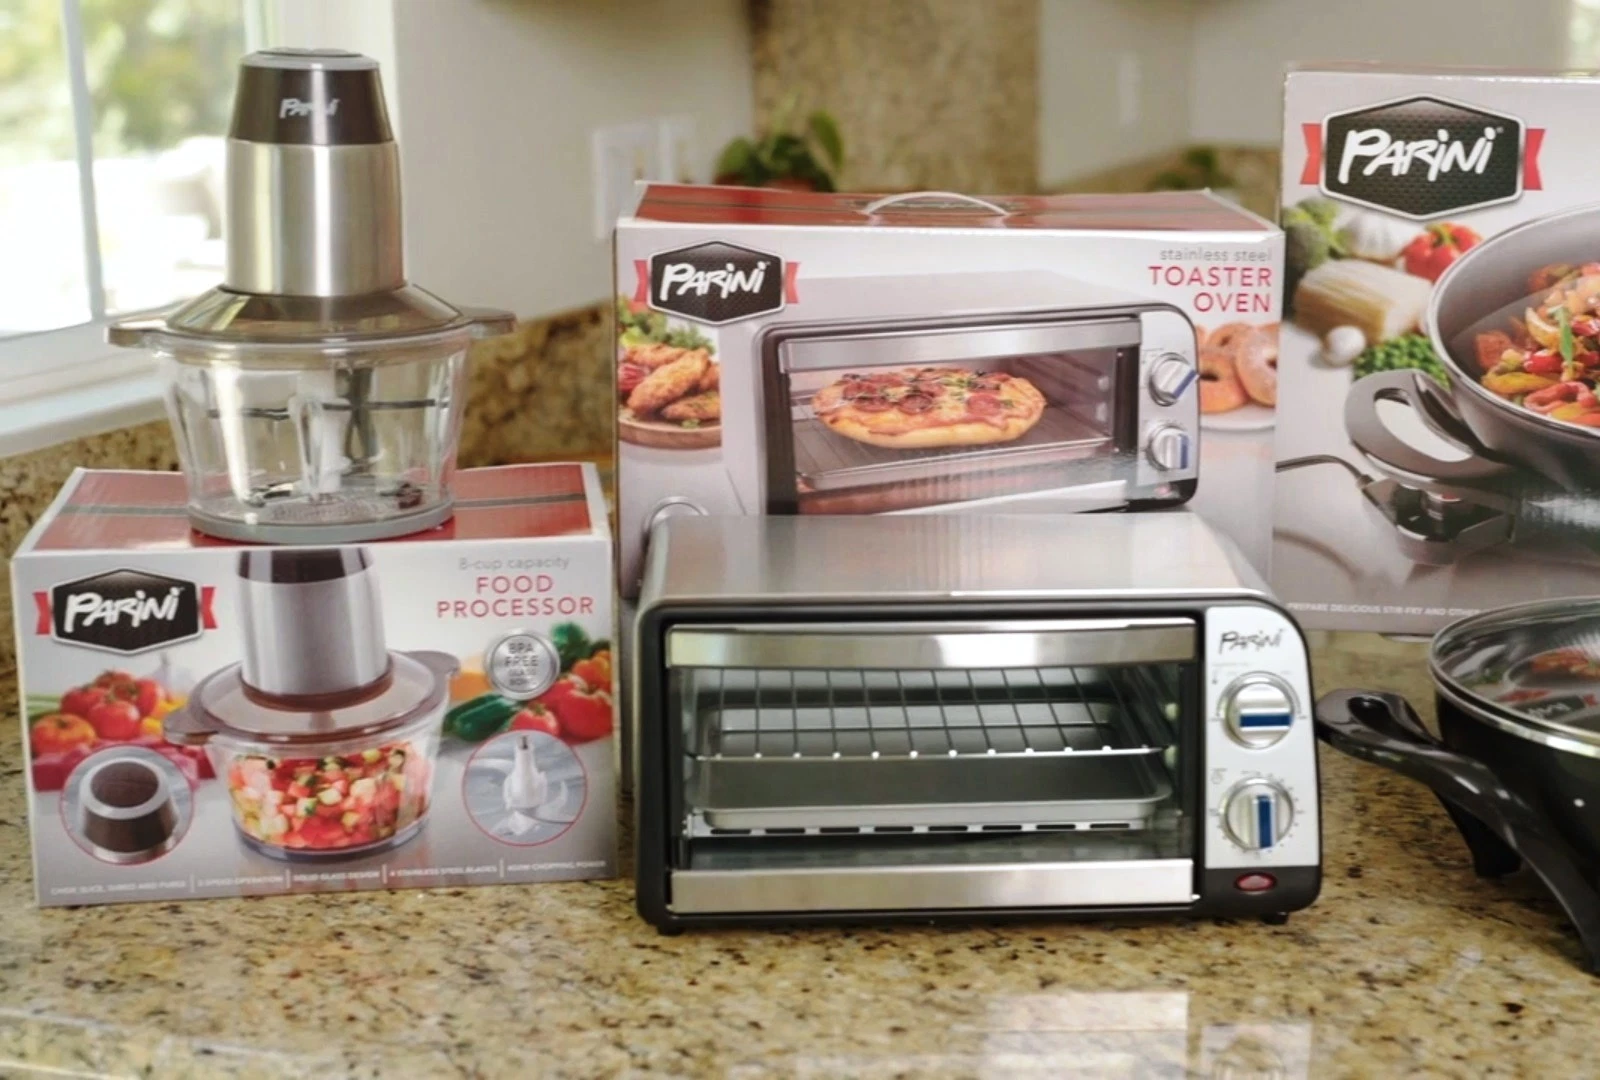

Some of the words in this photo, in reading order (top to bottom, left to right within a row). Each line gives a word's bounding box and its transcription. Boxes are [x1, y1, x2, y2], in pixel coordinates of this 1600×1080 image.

[1160, 247, 1228, 262] stainless
[1235, 248, 1273, 262] steel
[1148, 266, 1272, 287] TOASTER
[1193, 292, 1270, 313] OVEN
[508, 557, 570, 570] capacity
[476, 575, 553, 594] FOOD
[437, 597, 593, 618] PROCESSOR
